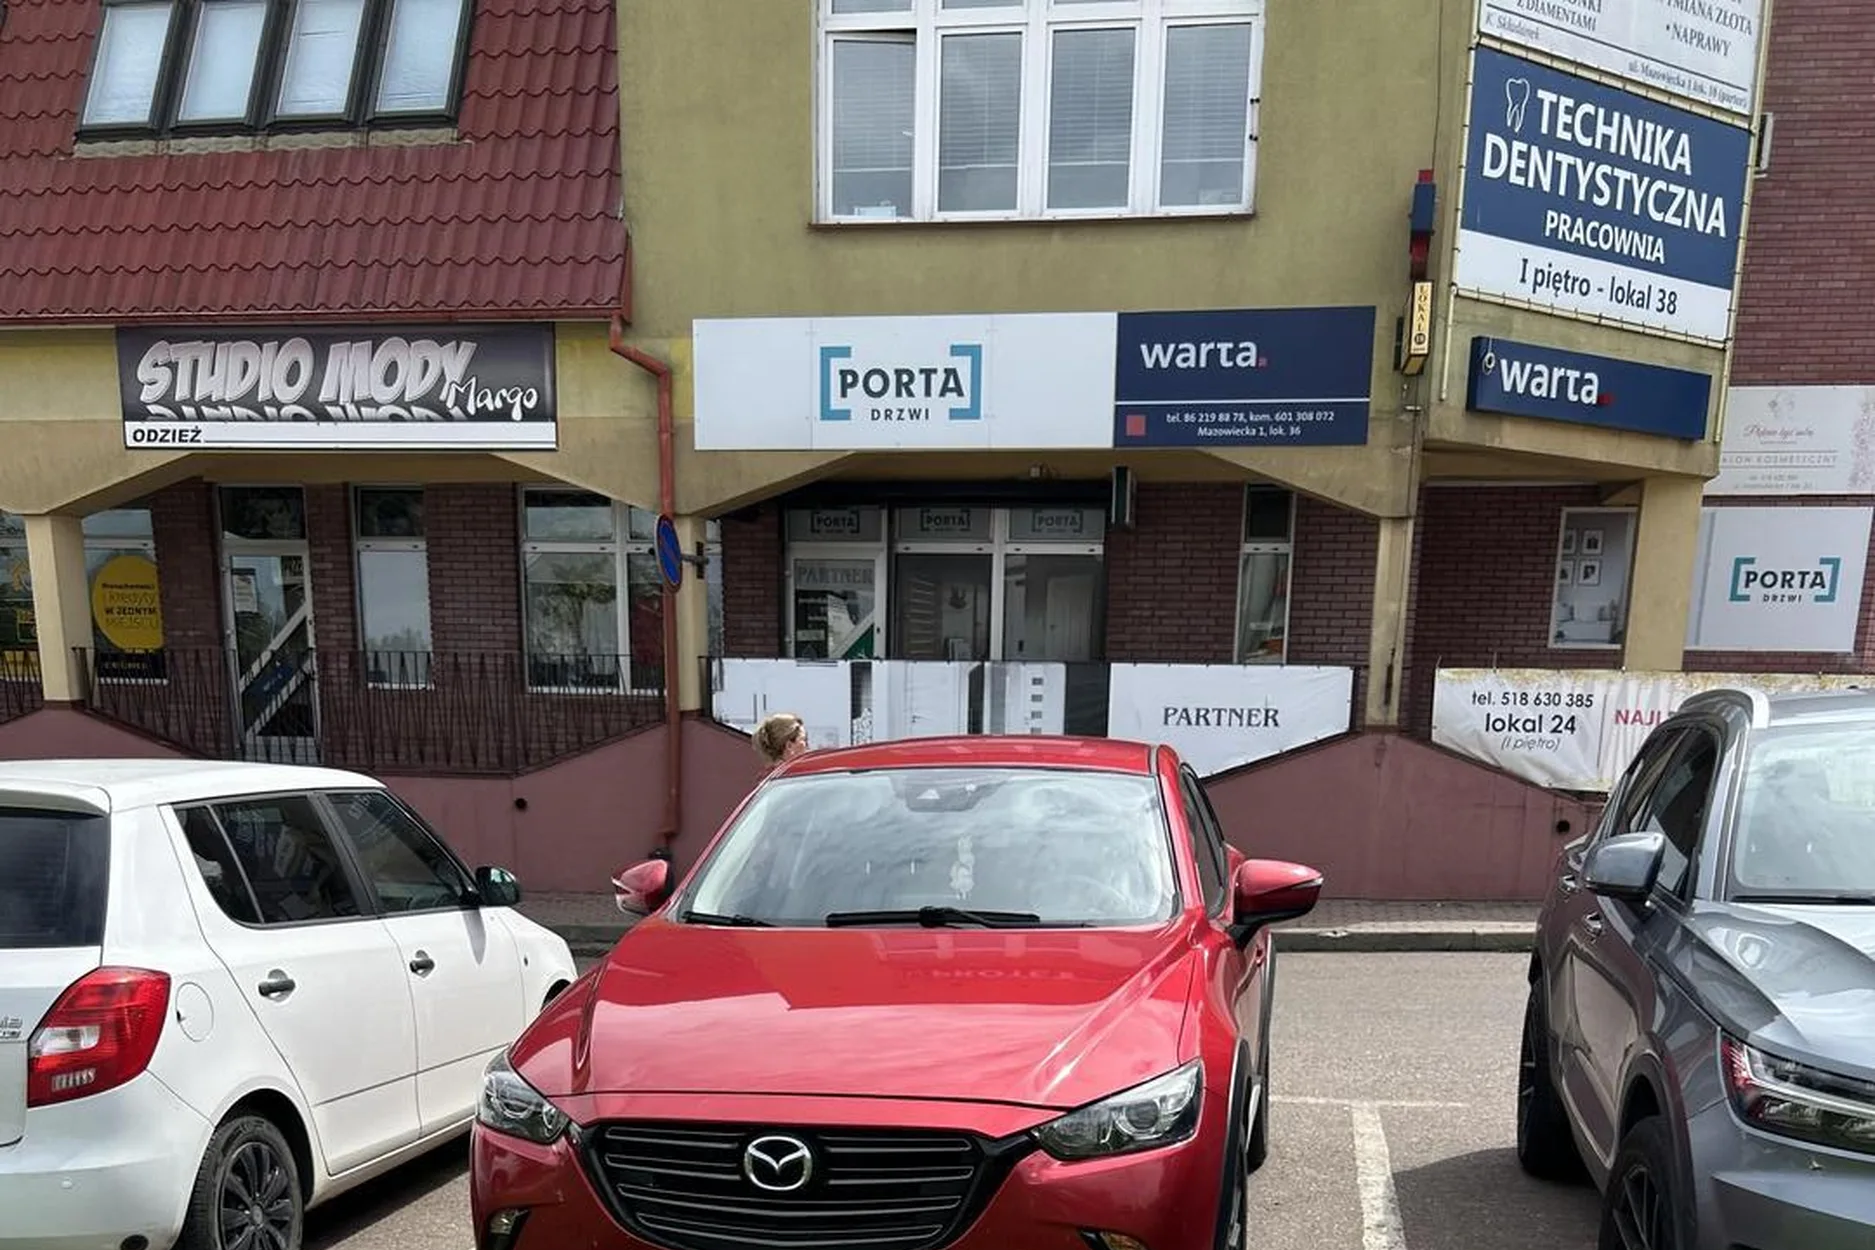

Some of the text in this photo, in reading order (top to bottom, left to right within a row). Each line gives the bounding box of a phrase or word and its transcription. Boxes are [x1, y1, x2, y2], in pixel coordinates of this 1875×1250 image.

[1526, 0, 1597, 33] DIAMENTAMI
[1715, 6, 1753, 36] ZŁOTA
[1672, 22, 1732, 57] NAPRAWY
[1537, 89, 1692, 176] TECHNIKA
[1482, 132, 1727, 238] DENTYSTYCZNA
[1545, 209, 1665, 265] PRACOWNIA
[1519, 258, 1529, 284] I
[1532, 263, 1592, 298] piętro
[1609, 276, 1652, 310] lokal
[1655, 289, 1678, 315] 38
[137, 336, 477, 404] STUDIO MODY
[838, 367, 965, 399] PORTA
[446, 377, 539, 422] Margo
[870, 408, 931, 421] DRZWI
[1198, 412, 1217, 423] 219
[1274, 411, 1293, 422] 601
[132, 424, 203, 444] ODZIEŻ
[1197, 426, 1257, 437] Mazowiecka
[815, 513, 856, 528] PORTA
[926, 510, 967, 527] PORTA
[1038, 511, 1079, 527] PORTA
[1744, 571, 1826, 589] PORTA
[1763, 594, 1802, 603] DRZWI
[1472, 691, 1594, 708] tel. 518 630 385
[1163, 706, 1280, 727] PARTNER
[1485, 713, 1577, 735] lokal 24
[1513, 736, 1561, 751] piętro)
